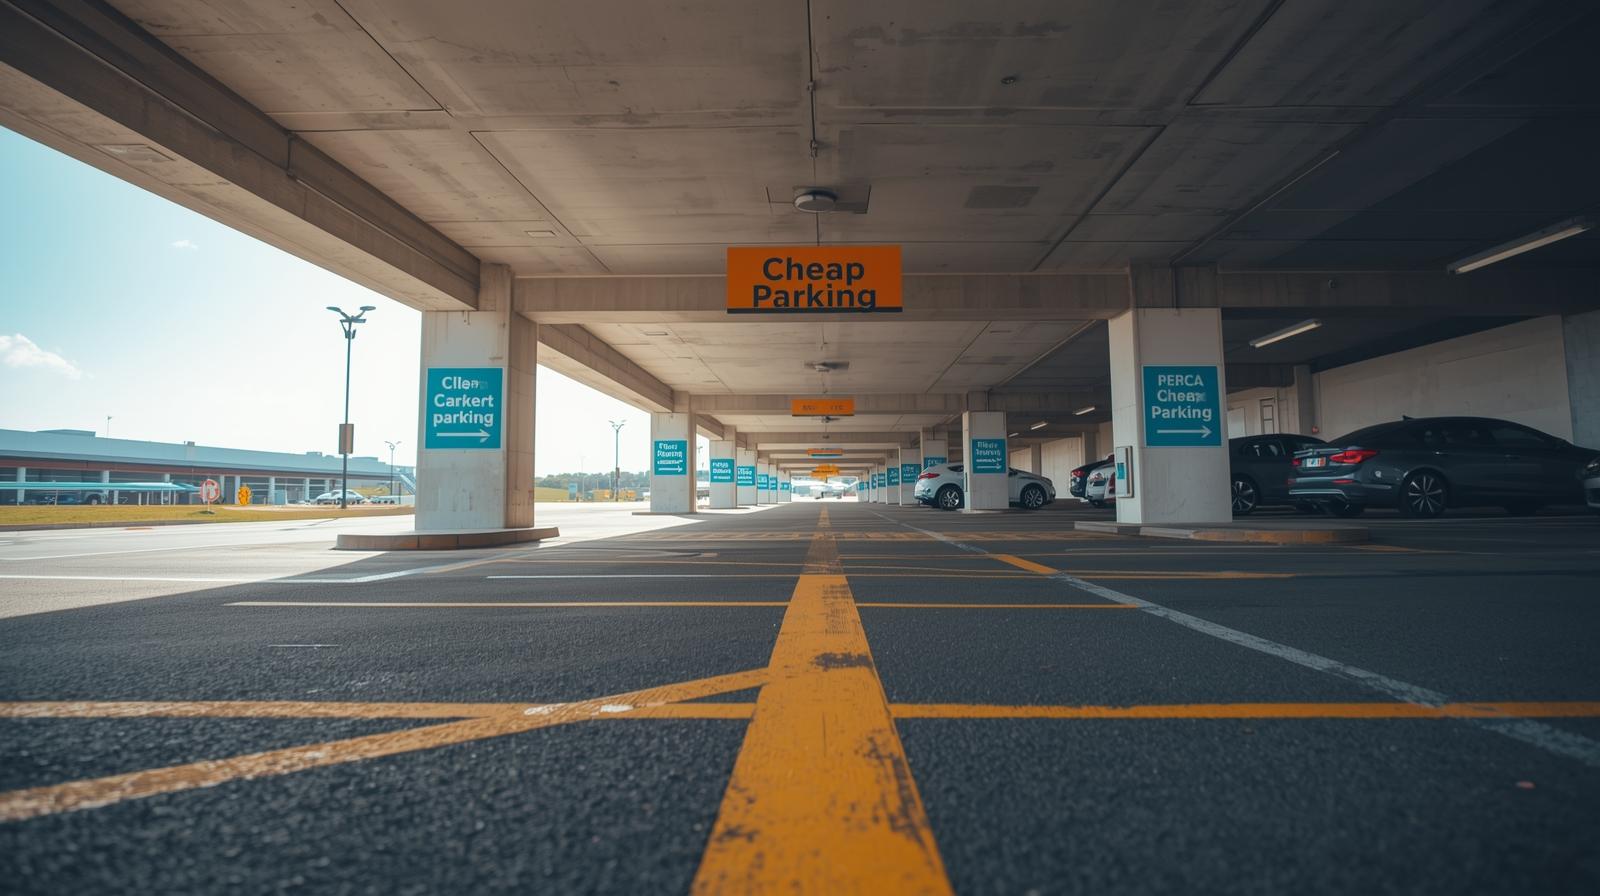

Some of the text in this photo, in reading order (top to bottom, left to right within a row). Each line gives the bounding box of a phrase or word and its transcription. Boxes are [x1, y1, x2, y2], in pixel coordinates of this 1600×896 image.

[763, 257, 865, 286] Cheap
[753, 284, 876, 312] Parking
[1158, 374, 1204, 387] PERCA
[434, 393, 495, 408] Carkert
[433, 410, 494, 427] parking
[1151, 405, 1212, 422] Parking
